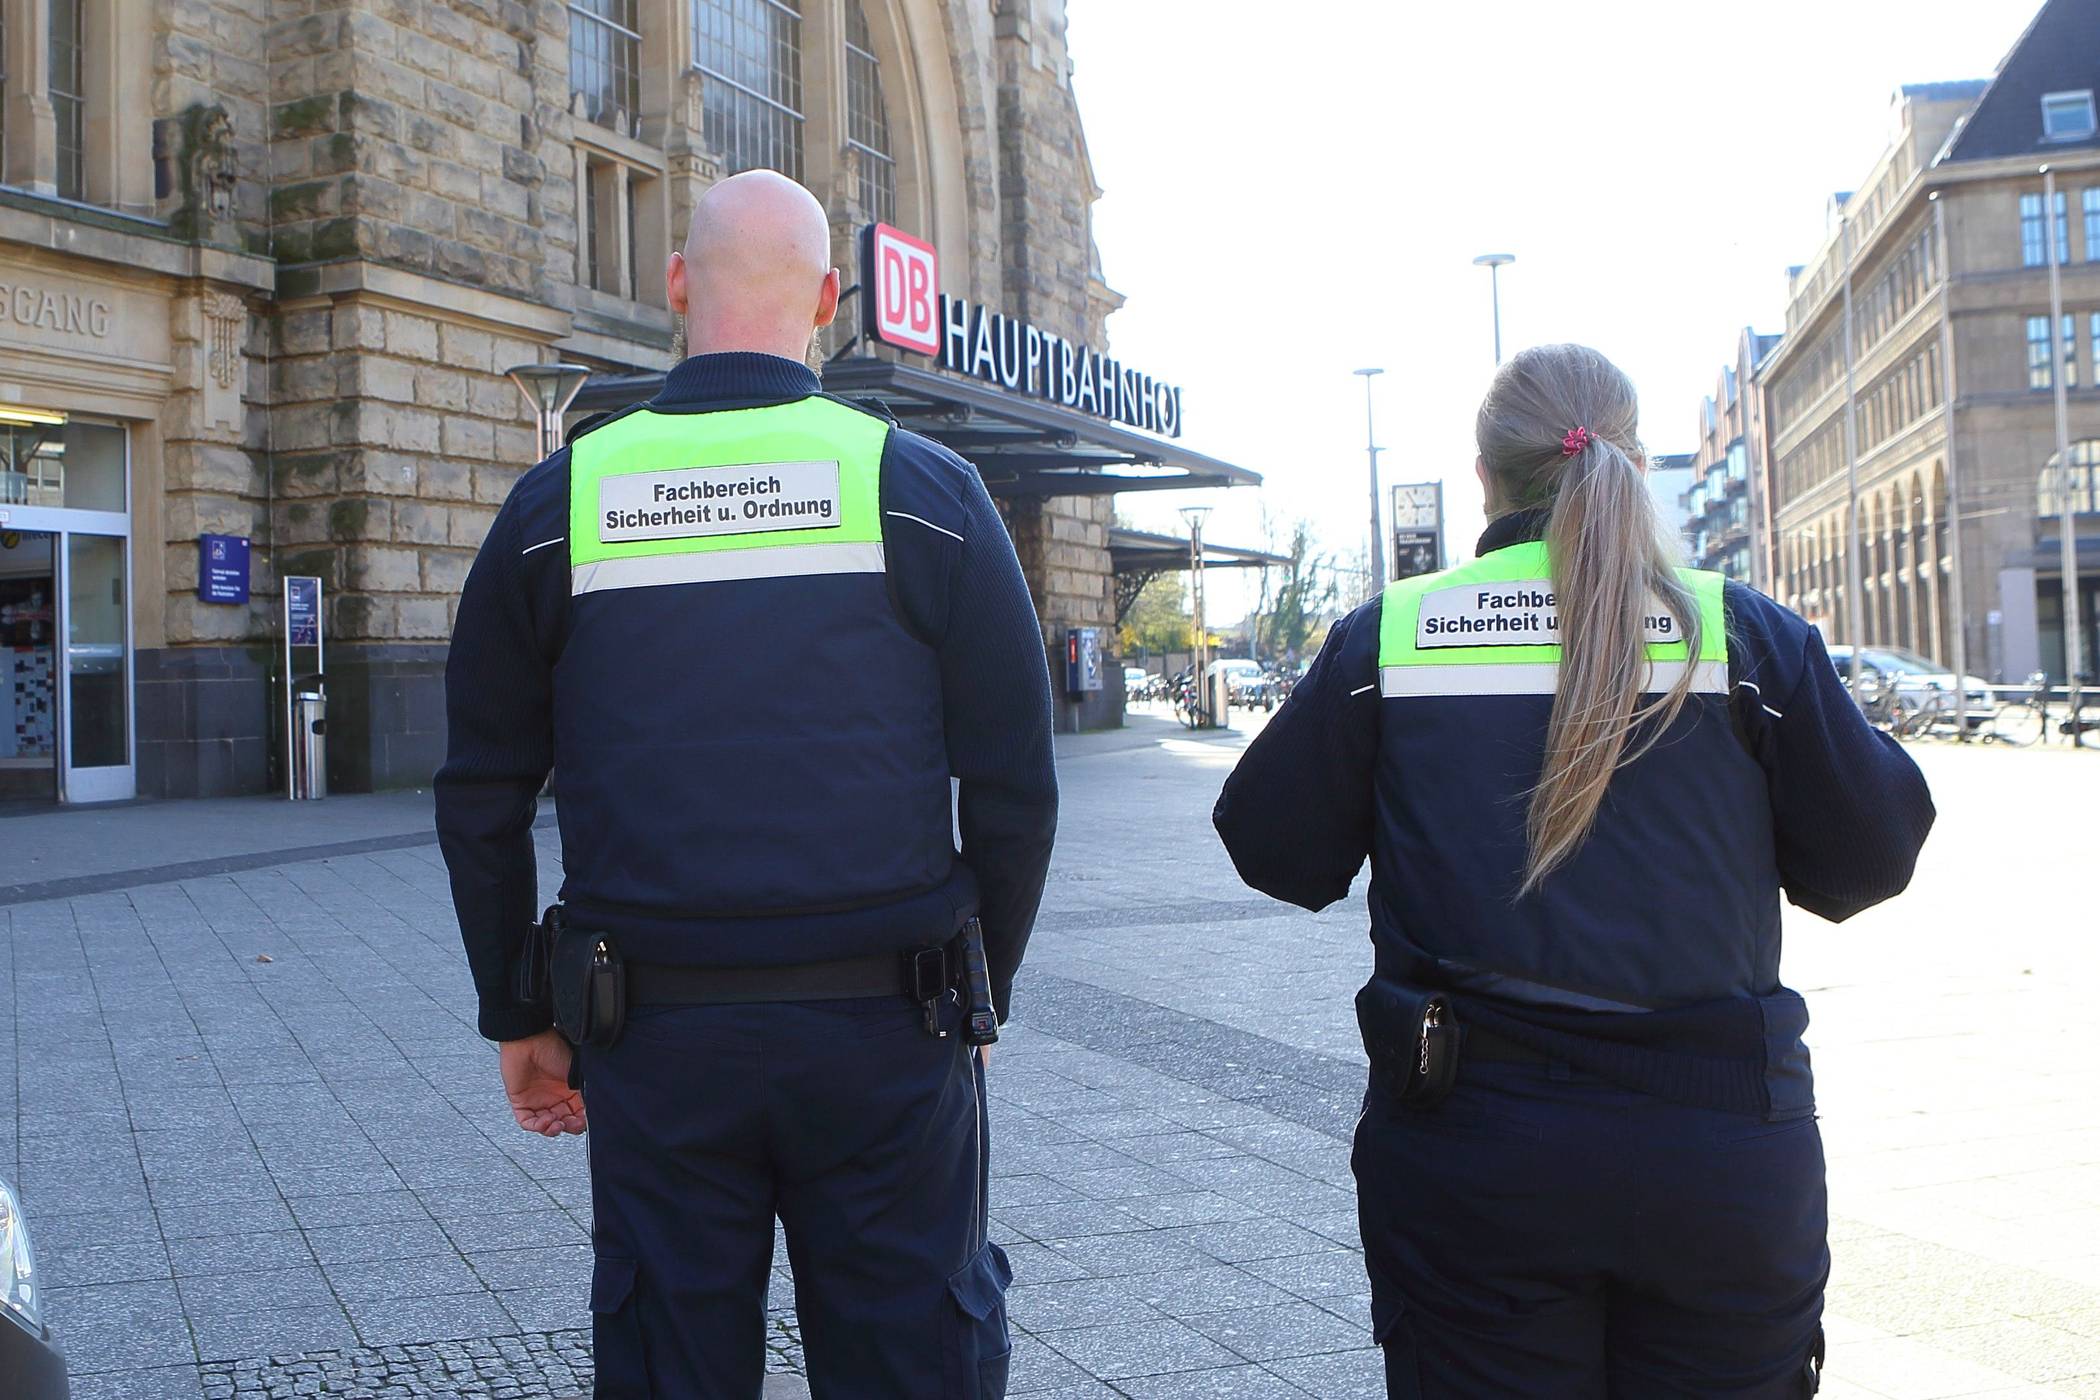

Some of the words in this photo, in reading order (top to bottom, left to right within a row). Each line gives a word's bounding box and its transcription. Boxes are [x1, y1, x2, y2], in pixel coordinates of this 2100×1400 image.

[884, 246, 929, 334] DB
[654, 476, 781, 502] Fachbereich
[606, 505, 711, 529] Sicherheit
[718, 507, 736, 521] u.
[743, 499, 832, 518] Ordnung
[1477, 590, 1556, 610] Fachbe
[1425, 612, 1539, 634] Sicherheit
